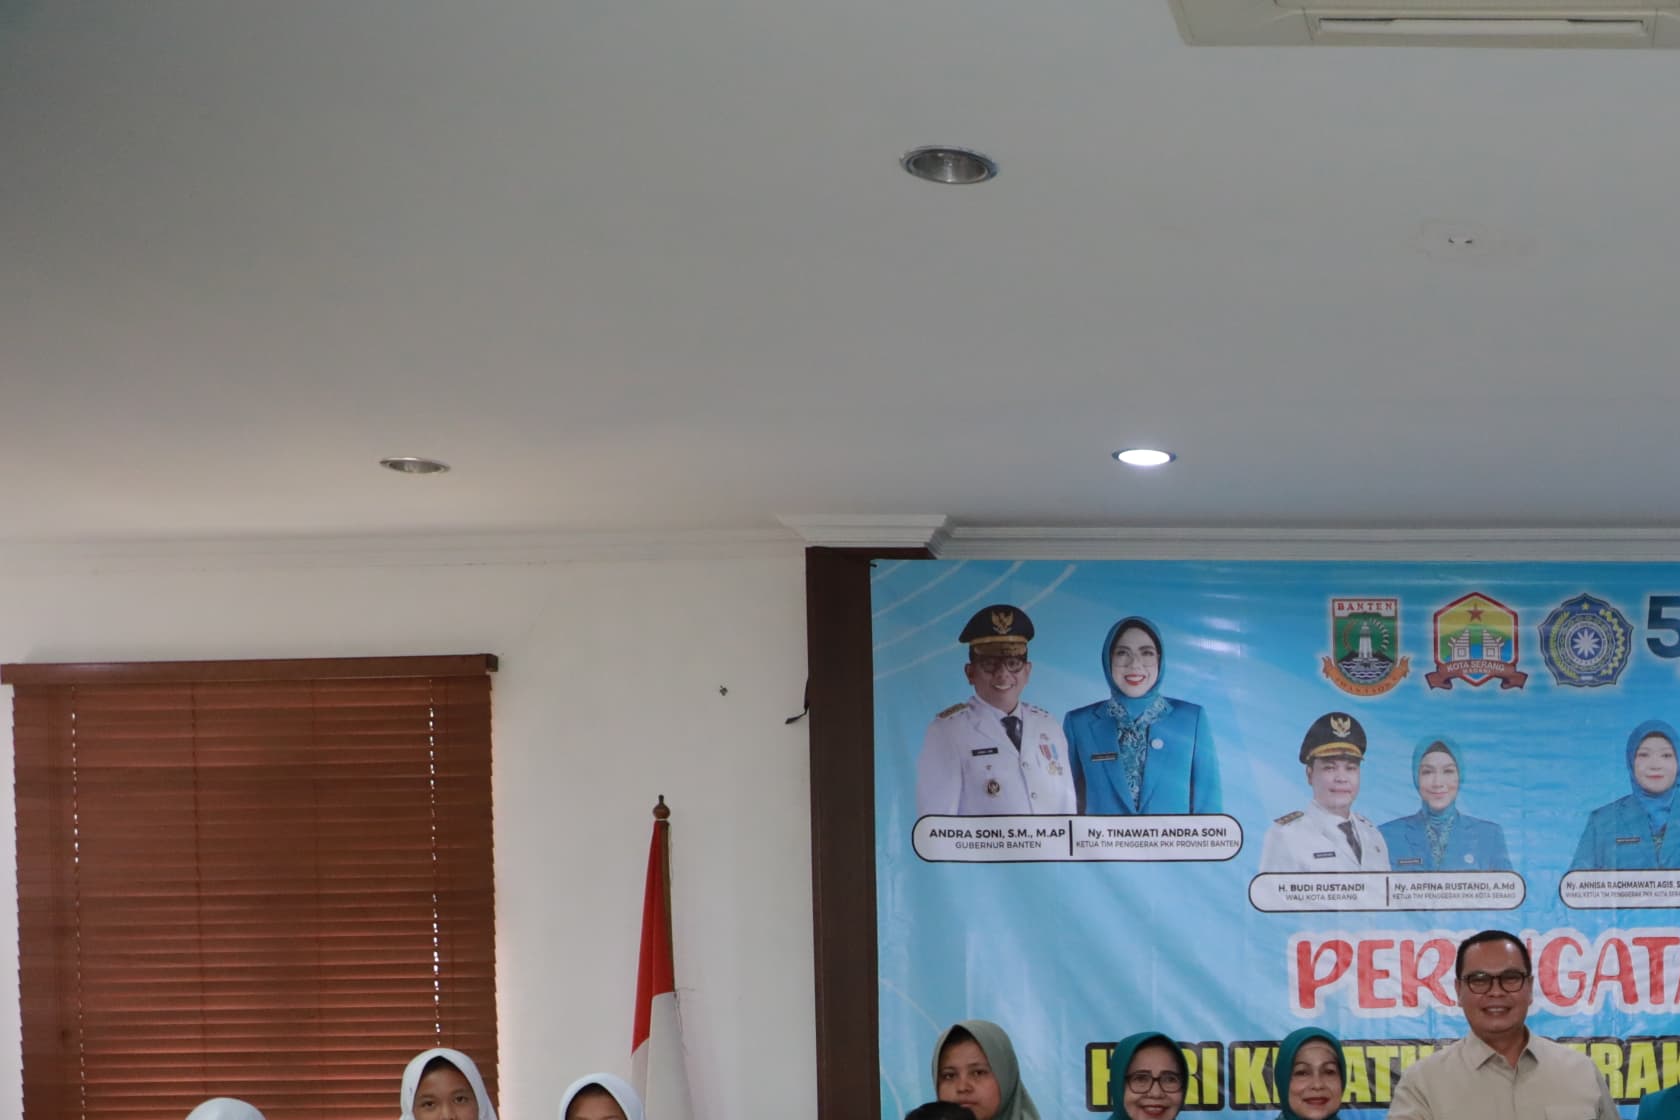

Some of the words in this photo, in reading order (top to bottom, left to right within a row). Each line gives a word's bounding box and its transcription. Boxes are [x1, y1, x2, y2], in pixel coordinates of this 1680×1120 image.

[1337, 602, 1392, 611] BANTEN
[1446, 661, 1470, 672] KOTA
[1470, 660, 1505, 672] SERANG
[929, 829, 973, 838] ANDRA
[975, 829, 1005, 839] SONI,
[1007, 829, 1033, 839] S.M.,
[1036, 829, 1066, 838] M.AP
[1088, 829, 1104, 839] Ny.
[1107, 829, 1159, 837] TINAWATI
[1161, 829, 1199, 837] ANDRA
[1201, 828, 1227, 837] SONI
[955, 841, 1005, 849] GUBERNUR
[1278, 884, 1288, 892] H.
[1290, 884, 1314, 892] BUDI
[1316, 883, 1365, 892] RUSTANDI
[1394, 883, 1408, 892] Ny.
[1445, 882, 1491, 891] RUSTANDI,
[1493, 881, 1515, 890] A.Md
[1566, 881, 1578, 890] Ny.
[1579, 881, 1605, 889] ANNISA
